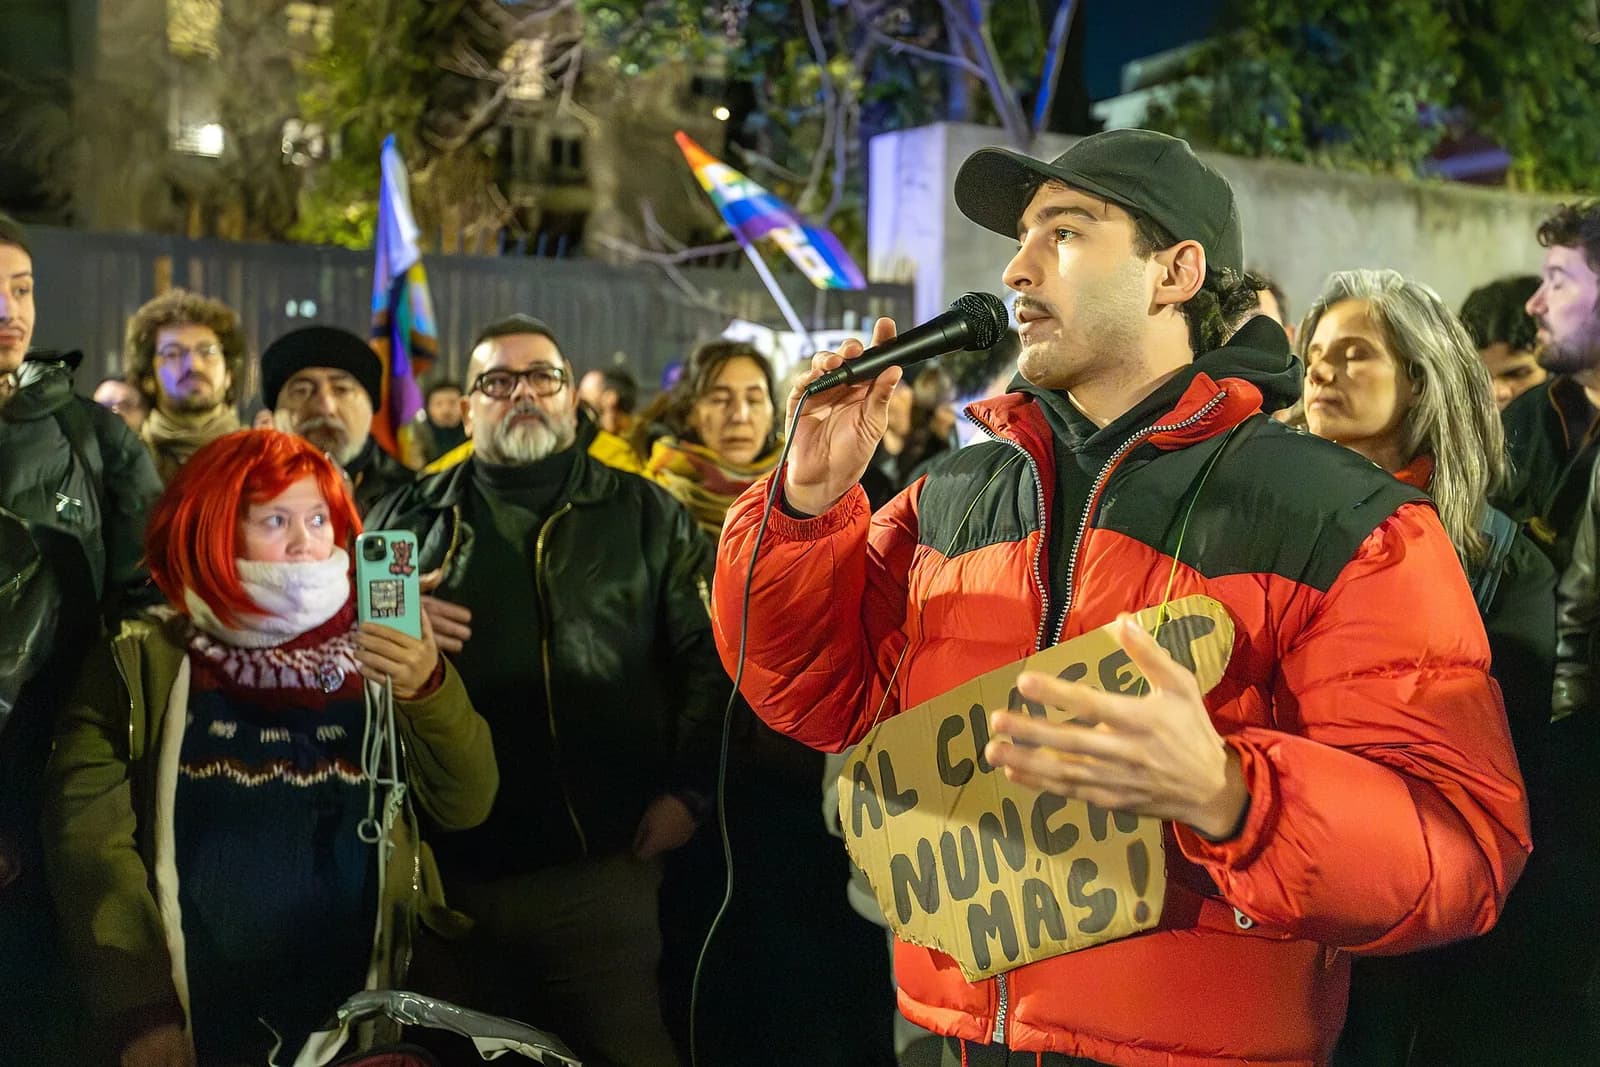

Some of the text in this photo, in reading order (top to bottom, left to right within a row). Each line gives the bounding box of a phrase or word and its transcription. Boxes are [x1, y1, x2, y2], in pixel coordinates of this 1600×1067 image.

[852, 615, 1215, 837] AL CLET
[967, 838, 1150, 970] MÁS!
